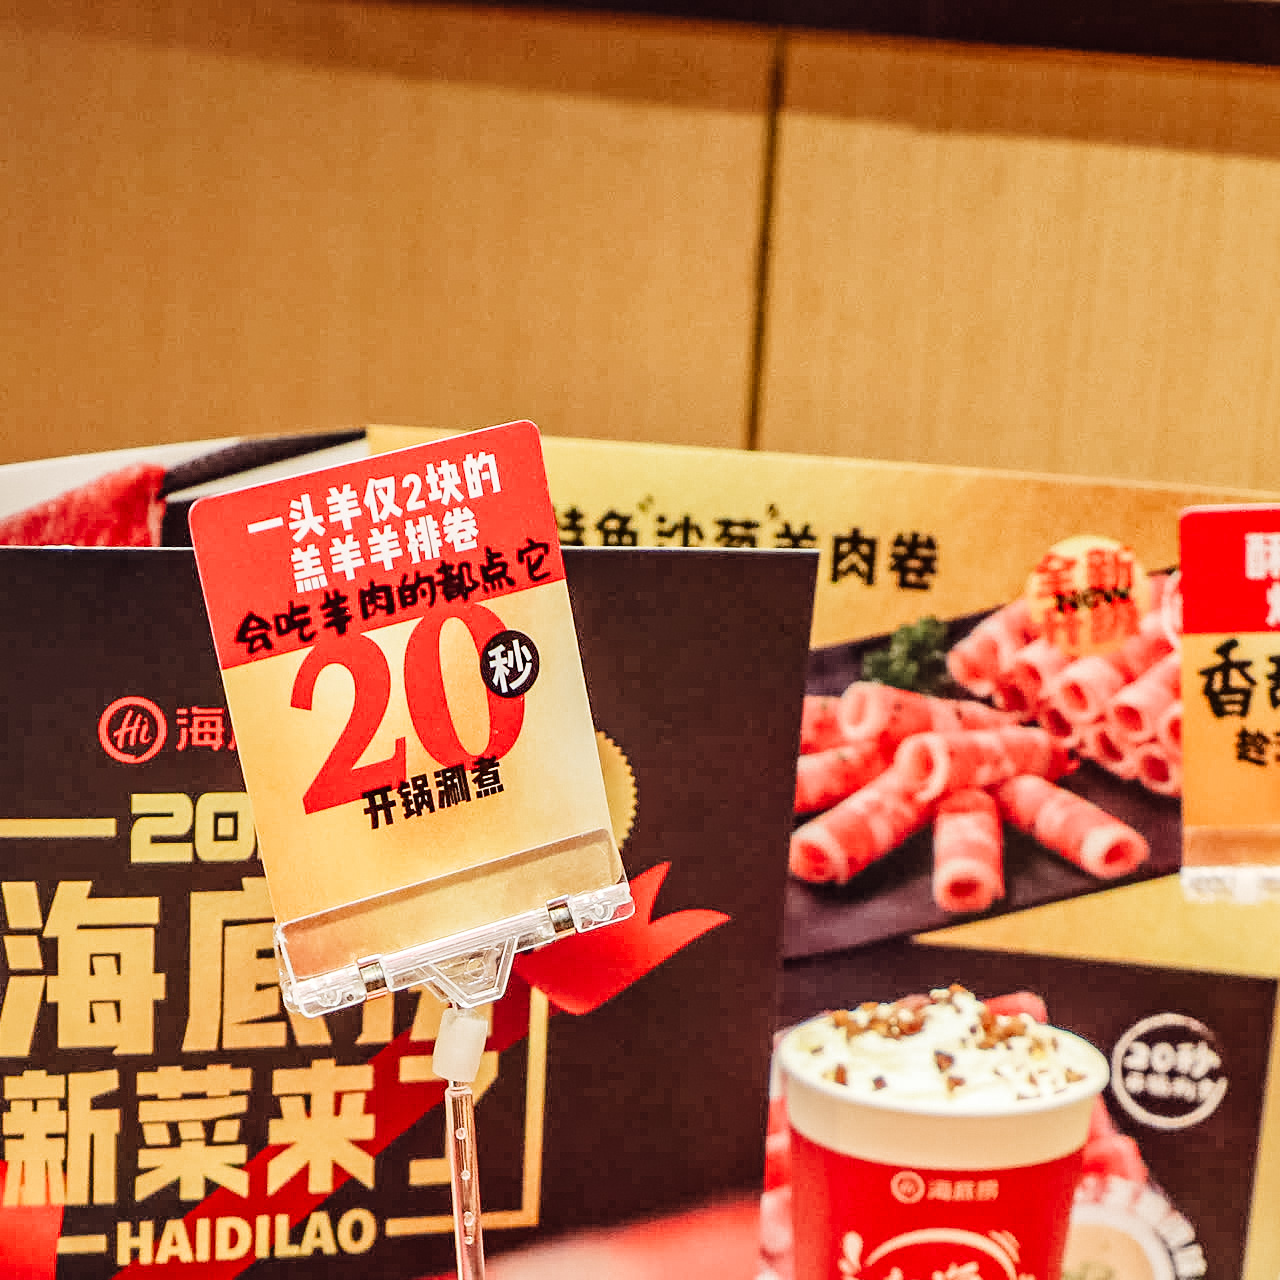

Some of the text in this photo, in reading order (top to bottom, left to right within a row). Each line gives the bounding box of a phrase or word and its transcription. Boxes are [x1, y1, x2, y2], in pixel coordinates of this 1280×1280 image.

[247, 451, 501, 538] 一头羊仅2块的
[291, 507, 480, 593] 羔羊羊排卷
[234, 537, 552, 655] 会吃羊肉的都点它
[176, 706, 238, 752] 海
[130, 792, 263, 864] 20
[362, 756, 505, 831] 开锅涮煮
[2, 1052, 500, 1208] 新菜来了
[116, 1206, 378, 1267] HAIDILAO
